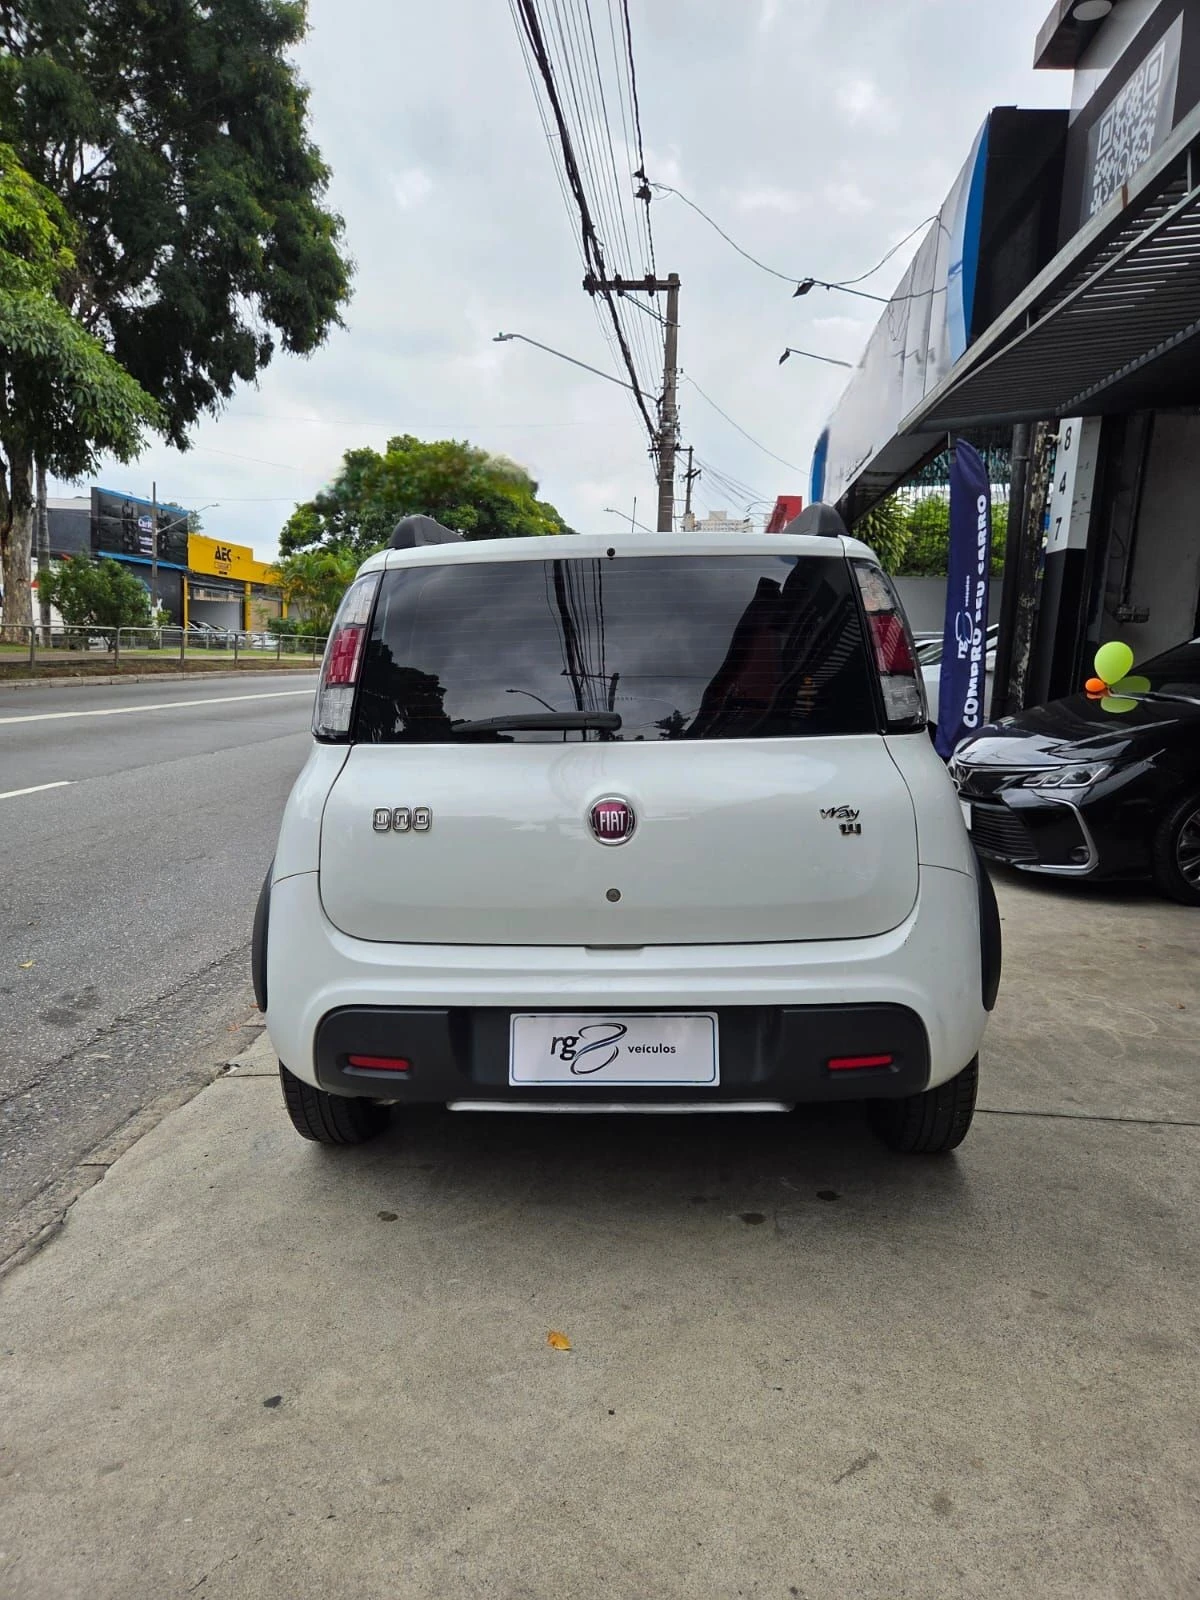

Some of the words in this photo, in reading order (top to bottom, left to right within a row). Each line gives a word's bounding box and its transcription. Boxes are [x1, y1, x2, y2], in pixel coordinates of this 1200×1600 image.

[215, 546, 232, 562] AEC
[963, 627, 982, 728] COMPRO
[977, 494, 987, 576] CARRO
[600, 811, 626, 831] FIAT
[628, 1043, 676, 1053] veículos
